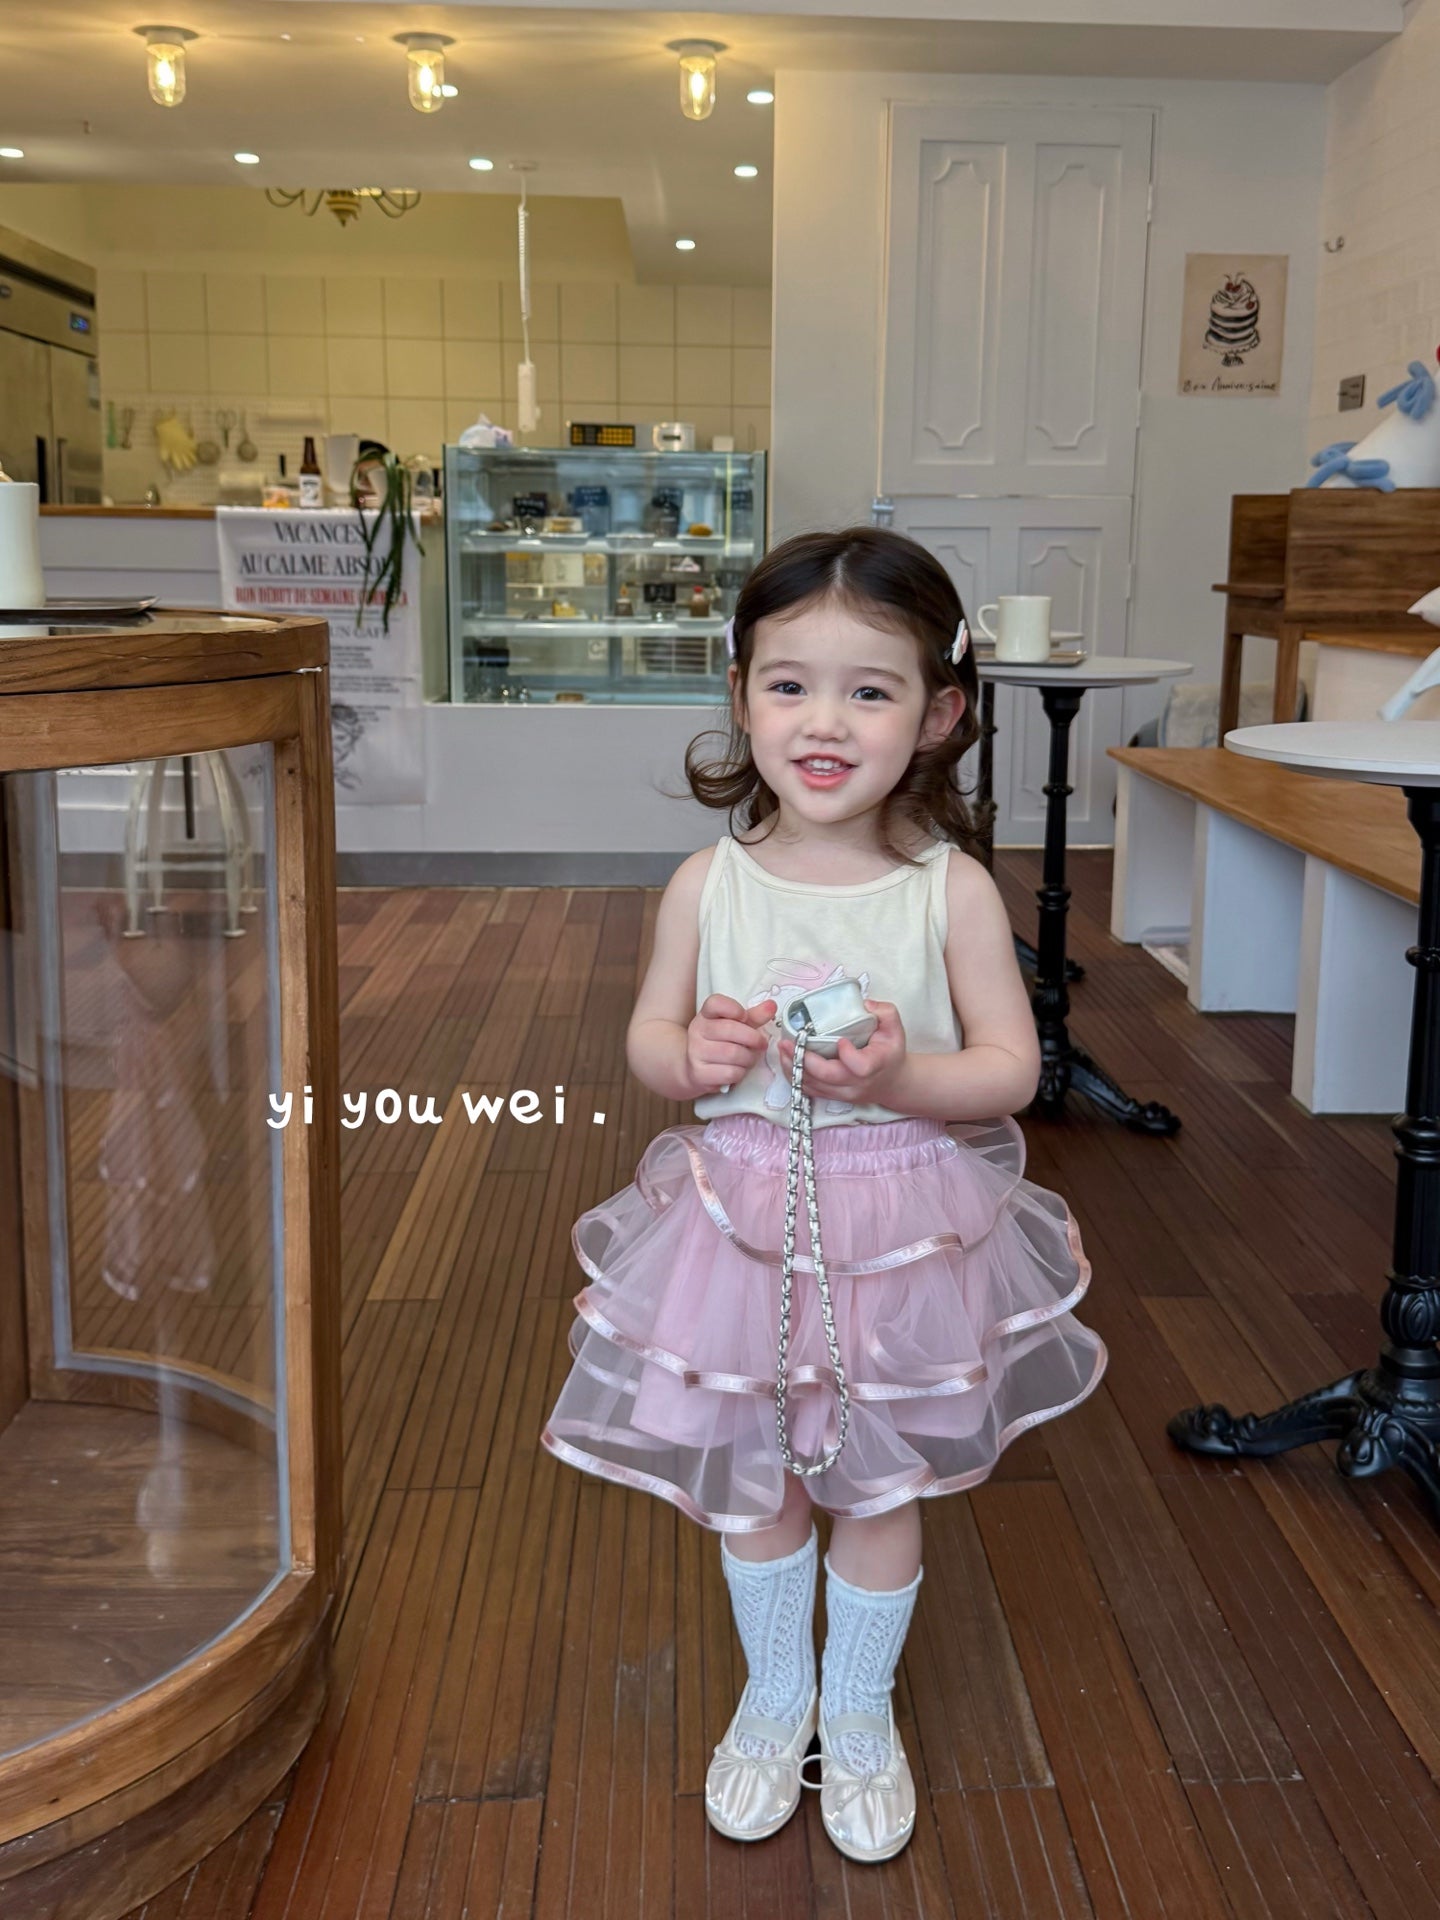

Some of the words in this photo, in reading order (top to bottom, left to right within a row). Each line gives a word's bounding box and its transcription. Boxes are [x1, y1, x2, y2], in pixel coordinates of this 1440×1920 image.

[274, 521, 367, 545] VACANCES
[239, 552, 262, 576] AU
[264, 553, 330, 577] CALME
